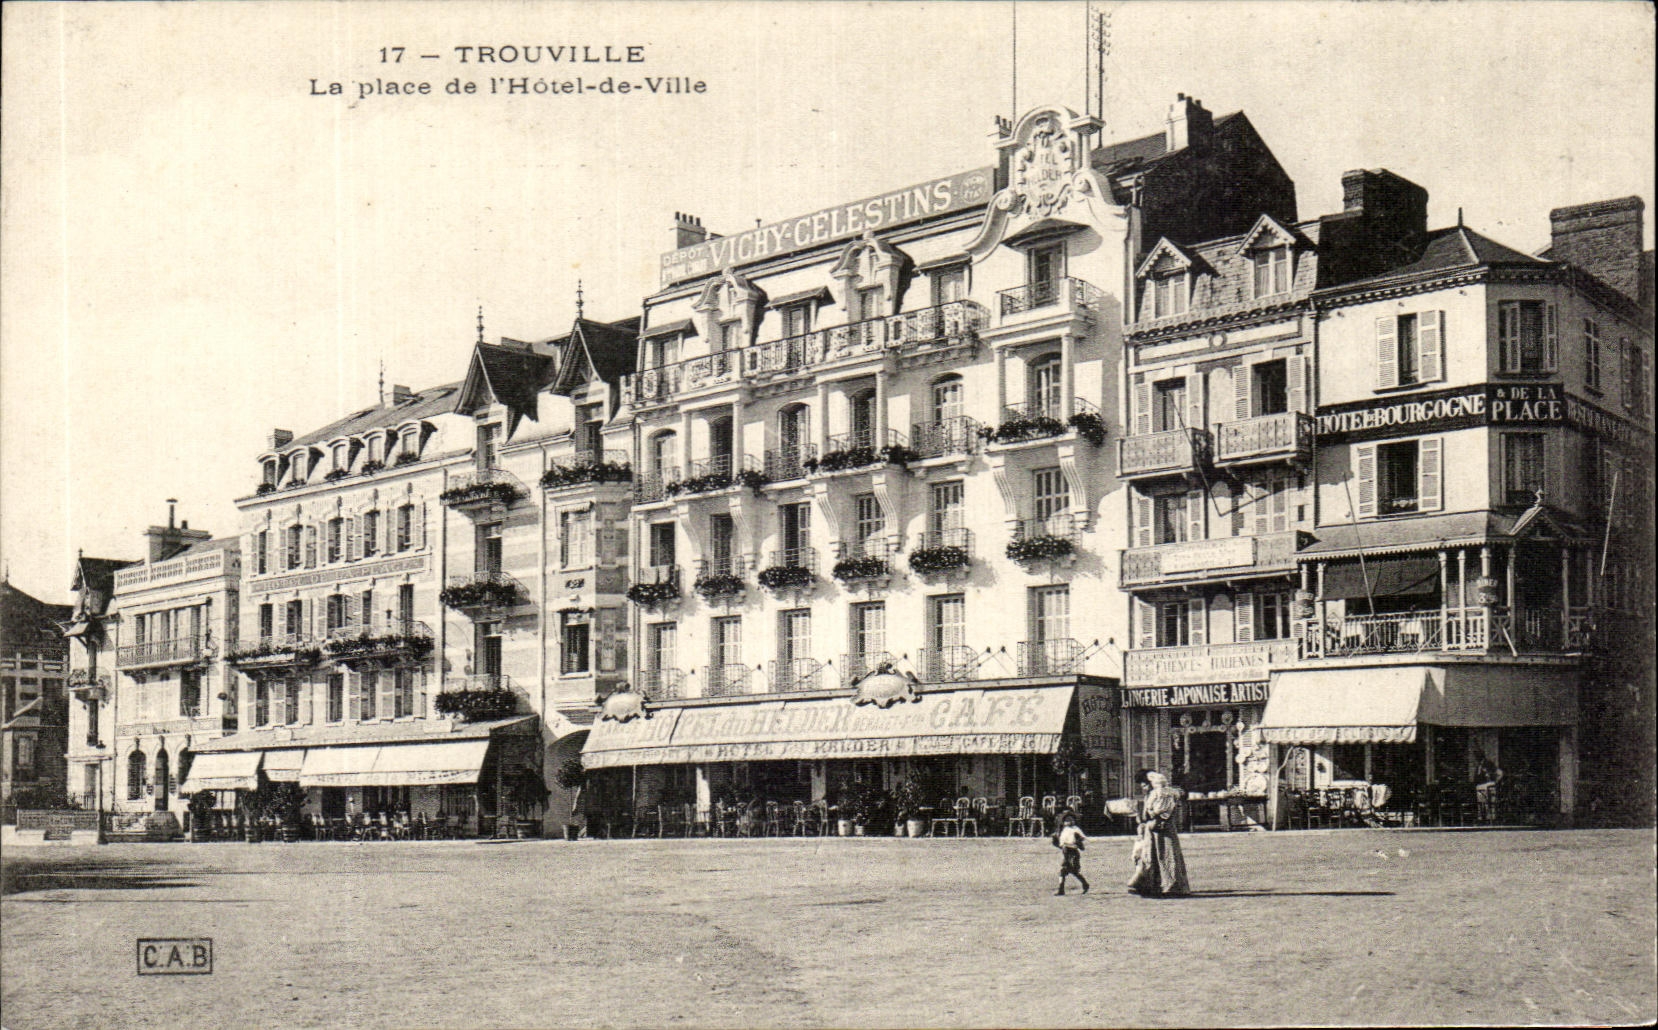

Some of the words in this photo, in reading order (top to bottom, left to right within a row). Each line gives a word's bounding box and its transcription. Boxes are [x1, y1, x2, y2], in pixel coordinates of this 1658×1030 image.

[1511, 387, 1530, 400] DE
[1537, 387, 1557, 400] LA
[1375, 393, 1486, 428] BOURGOGNE
[1491, 400, 1563, 422] PLACE
[1120, 688, 1169, 709] LINGERIE
[1170, 683, 1230, 706] JAPONAISE
